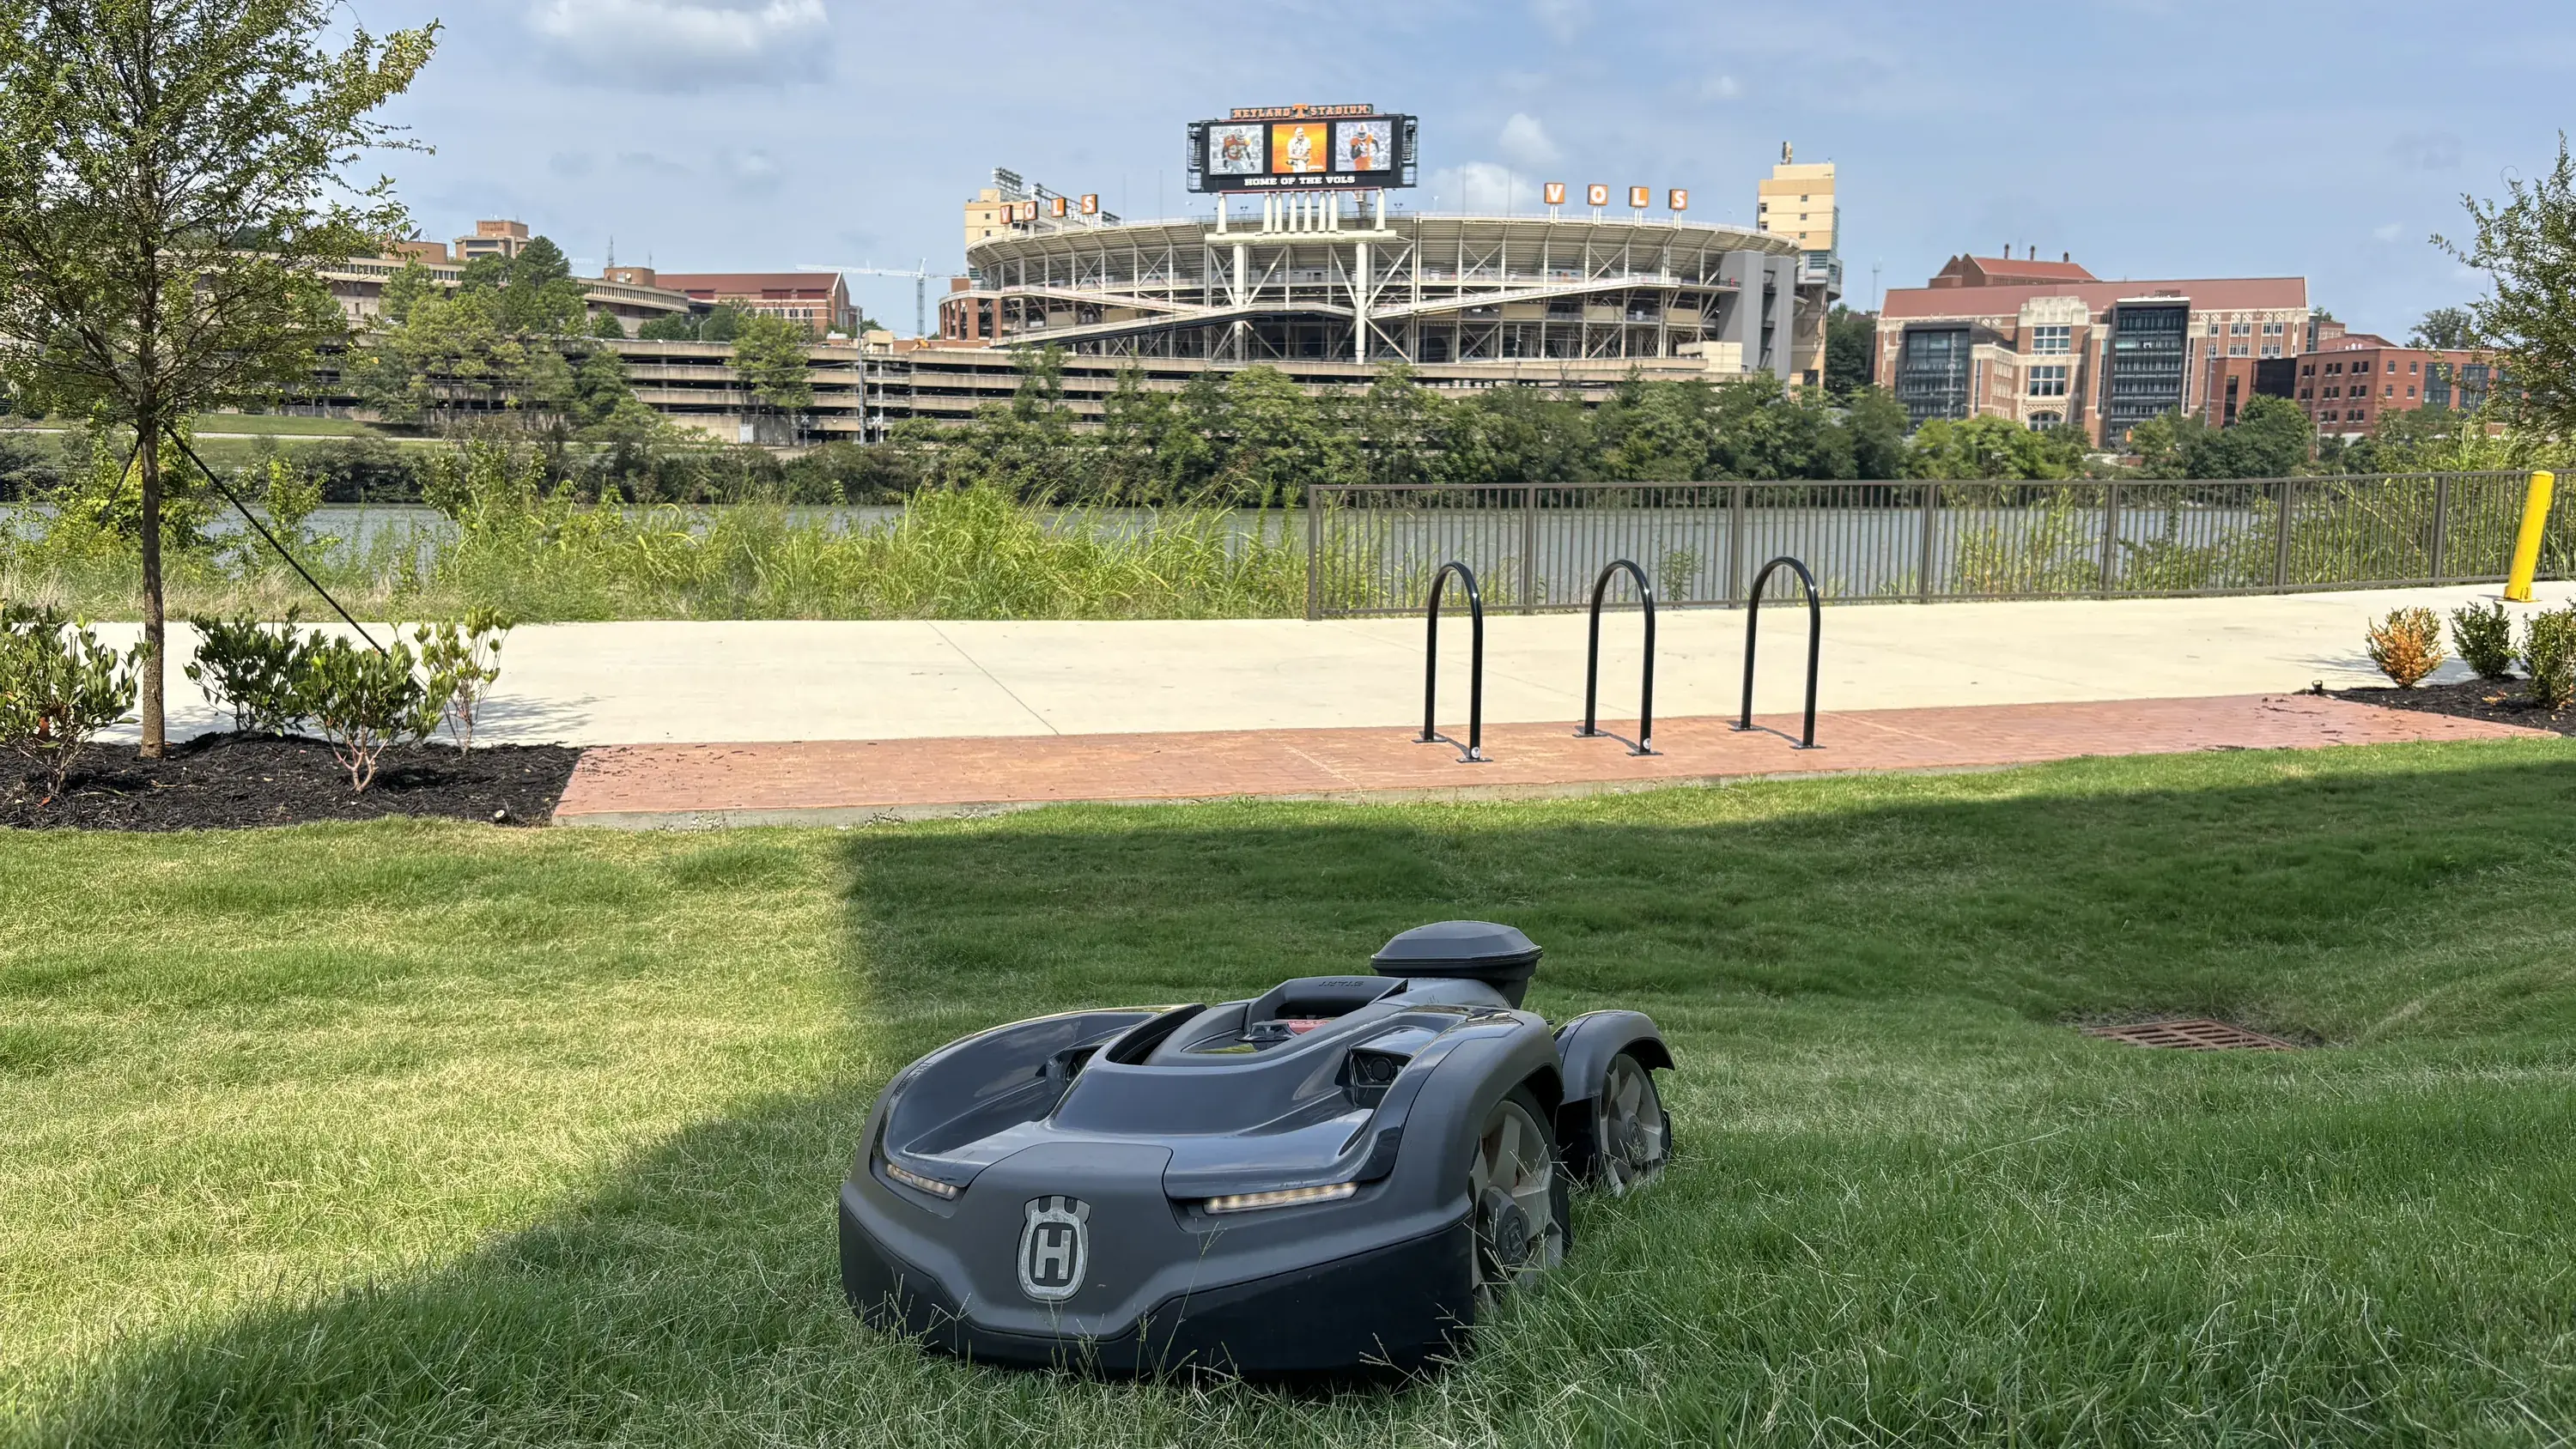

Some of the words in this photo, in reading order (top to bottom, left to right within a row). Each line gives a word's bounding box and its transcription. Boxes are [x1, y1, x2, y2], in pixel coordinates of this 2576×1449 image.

[1292, 103, 1309, 118] T
[1309, 105, 1367, 115] STADIUM
[1244, 178, 1278, 186] HOME
[1326, 175, 1355, 184] VOLS
[1546, 184, 1685, 208] VOLS
[1001, 196, 1094, 222] VOLS
[1035, 1228, 1072, 1280] H
